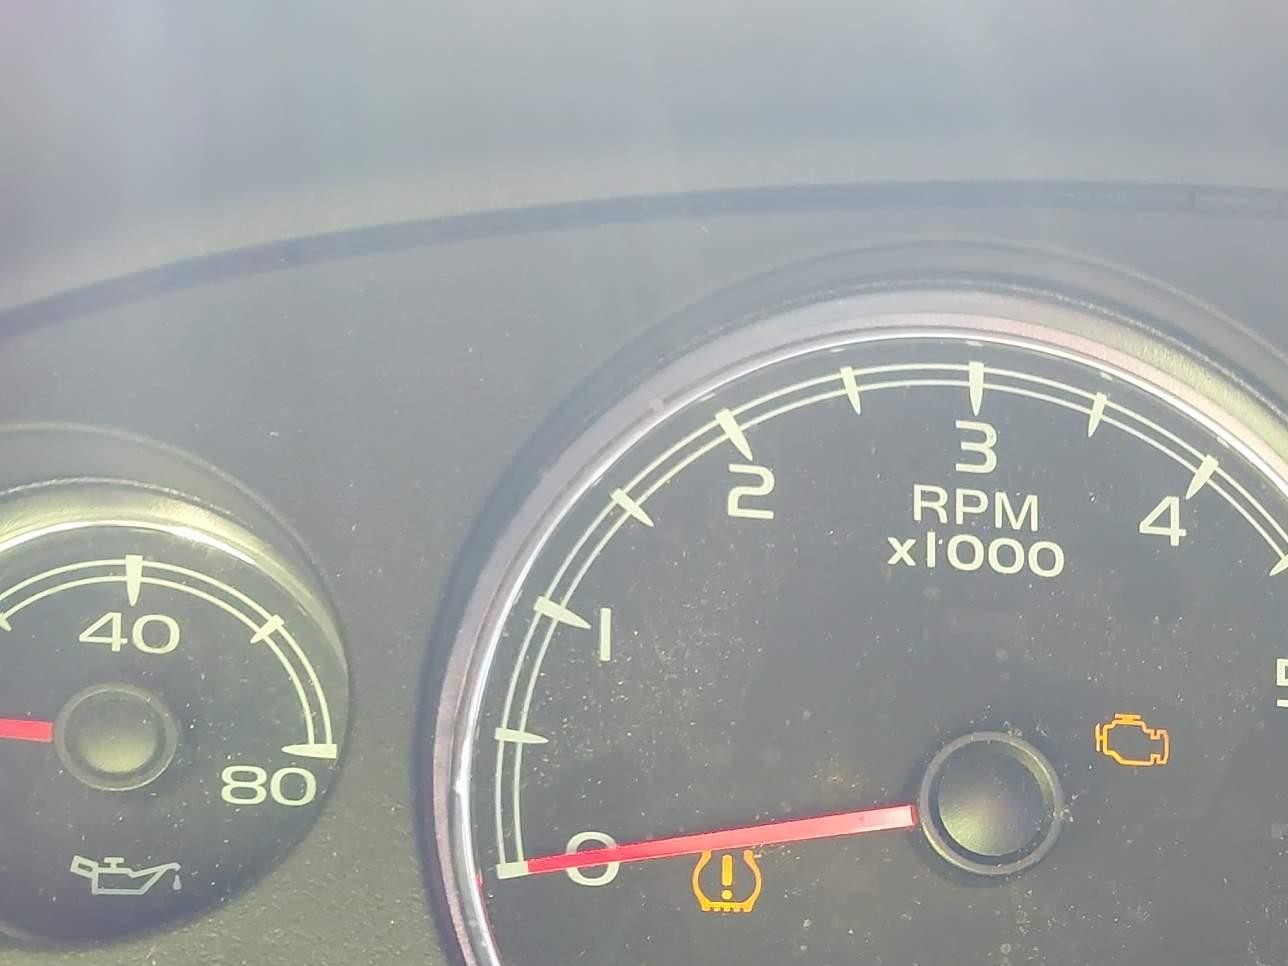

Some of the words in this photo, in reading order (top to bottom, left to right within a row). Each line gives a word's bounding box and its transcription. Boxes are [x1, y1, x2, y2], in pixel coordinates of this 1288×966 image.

[955, 420, 998, 474] 3
[727, 464, 775, 519] 2
[913, 484, 1040, 532] RPM
[1138, 496, 1187, 546] 4
[886, 531, 1066, 578] x1000
[78, 611, 181, 654] 40
[600, 607, 612, 662] 1
[220, 764, 317, 806] 80
[565, 830, 620, 887] 0
